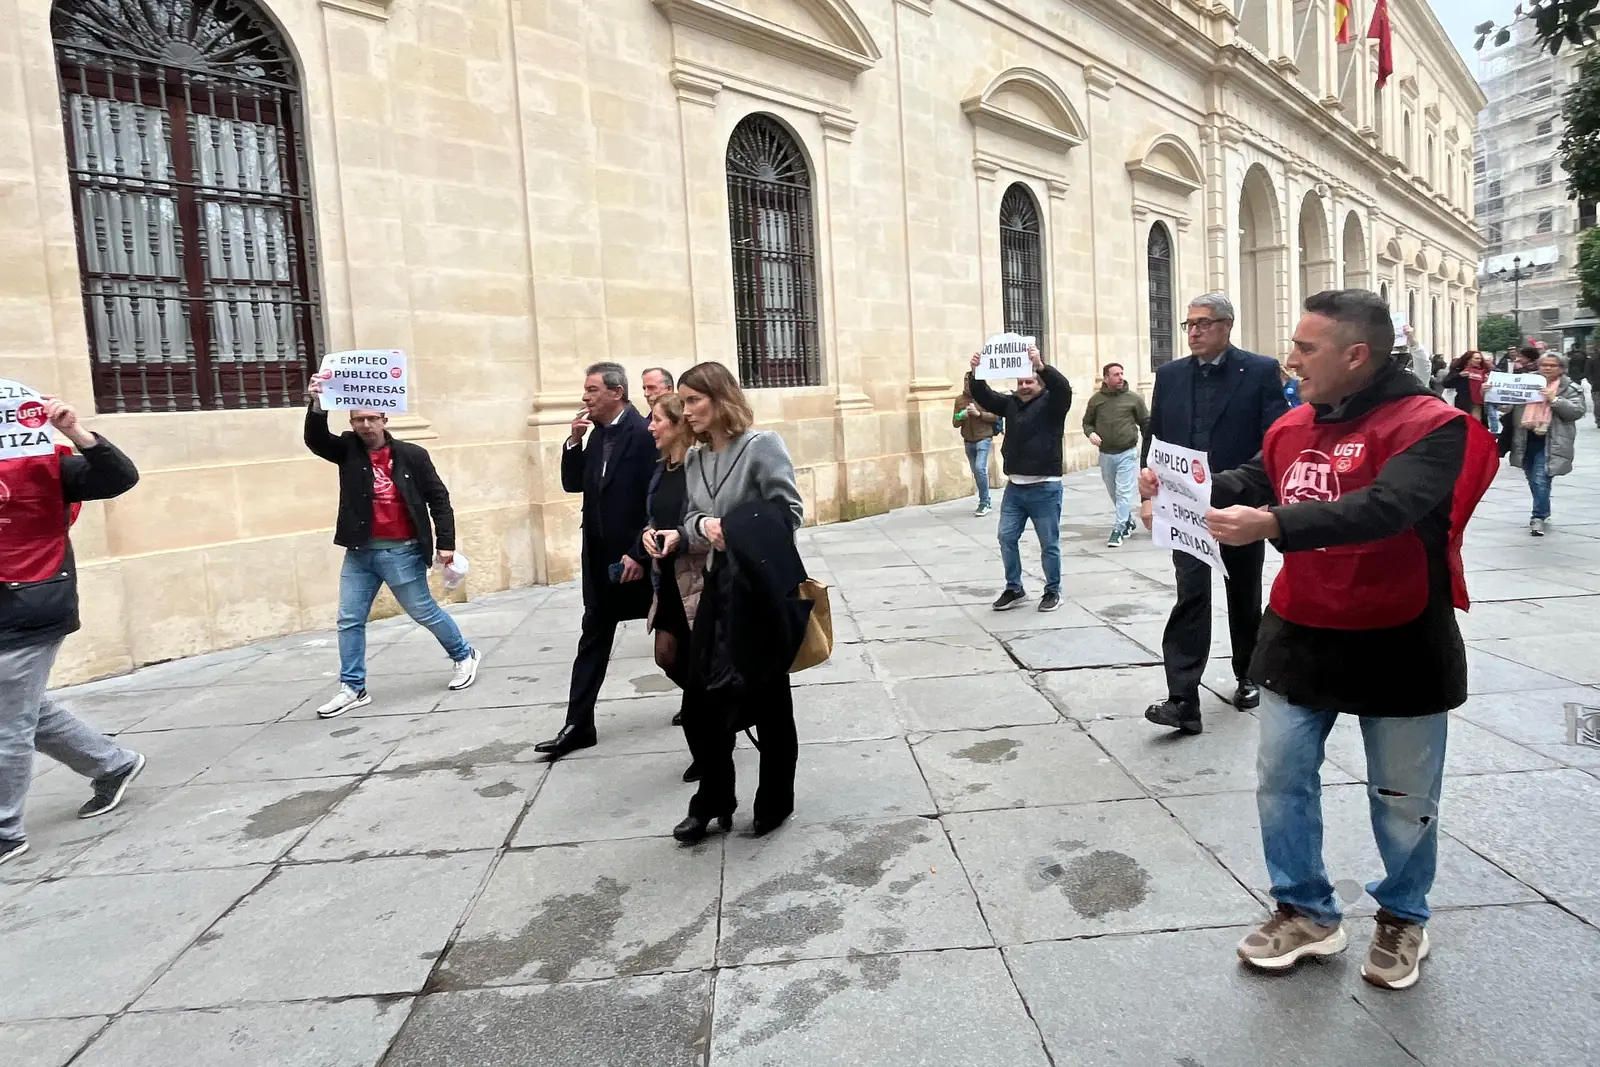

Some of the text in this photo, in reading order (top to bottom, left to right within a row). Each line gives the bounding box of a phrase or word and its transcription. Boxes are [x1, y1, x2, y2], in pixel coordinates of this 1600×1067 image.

[340, 356, 388, 366] EMPLEO
[989, 357, 1022, 369] AL PARO
[334, 368, 388, 380] PÚBLICO
[343, 384, 406, 395] EMPRESAS
[335, 396, 397, 407] PRIVADAS
[18, 406, 44, 420] UGT
[1333, 443, 1365, 457] UGT
[1154, 448, 1189, 475] EMPLEO
[1284, 461, 1332, 493] UGT
